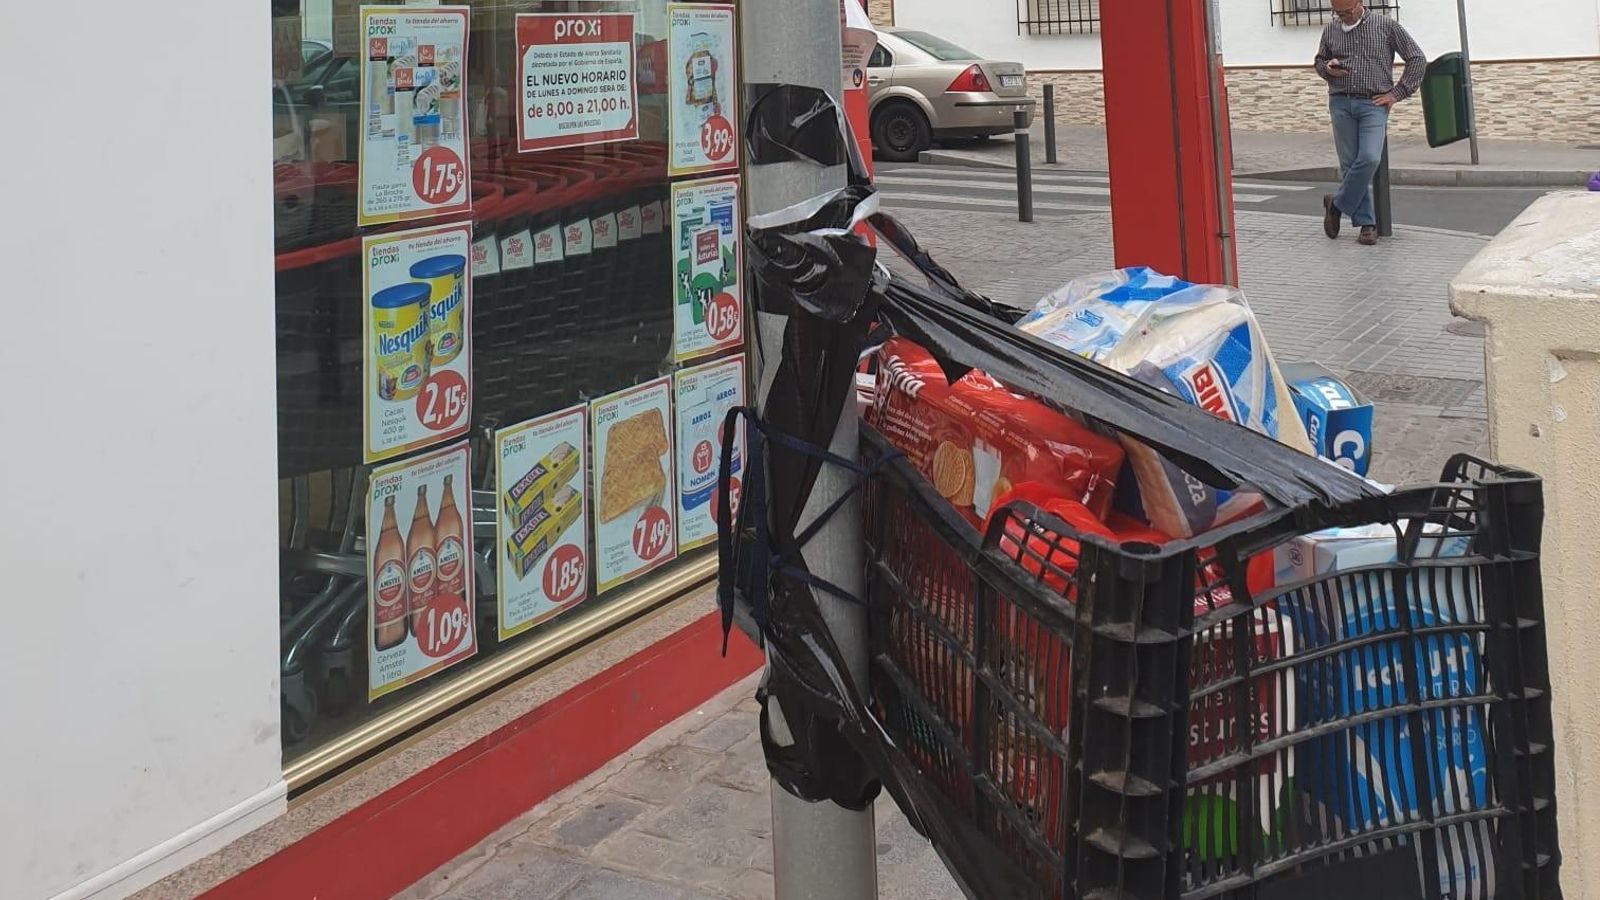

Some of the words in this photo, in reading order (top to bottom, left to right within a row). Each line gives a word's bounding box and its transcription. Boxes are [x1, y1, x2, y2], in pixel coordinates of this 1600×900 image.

[369, 16, 396, 25] tiendas
[672, 18, 690, 26] proxi
[368, 26, 396, 36] proxi
[554, 20, 601, 40] proxi
[527, 75, 539, 87] EL
[542, 73, 578, 86] NUEVO
[582, 70, 626, 83] HORARIO
[538, 89, 559, 97] LUNES
[568, 86, 598, 95] DOMINGO
[528, 104, 543, 118] de
[546, 101, 574, 118] 8,00
[577, 103, 584, 114] a
[587, 98, 617, 115] 21,00
[620, 97, 630, 110] h.
[704, 122, 732, 156] 3,99€
[423, 156, 464, 198] 1,75€
[676, 198, 693, 207] proxi
[372, 246, 400, 256] tiendas
[372, 254, 400, 268] proxi
[430, 281, 462, 321] squik
[379, 310, 429, 355] Nesquik
[423, 382, 467, 424] 2,15€
[598, 404, 618, 414] tiendas
[381, 416, 406, 427] Nesquik
[598, 410, 618, 425] proxi
[503, 442, 526, 458] proxi
[375, 474, 402, 488] tiendas
[690, 470, 715, 488] NOMEN
[374, 484, 402, 500] proxi
[637, 518, 670, 556] 7,49€
[551, 557, 583, 597] 1,85€
[428, 607, 468, 652] 1,09€
[378, 649, 406, 664] Cerveza
[380, 658, 405, 672] Amstel
[386, 670, 401, 680] litro
